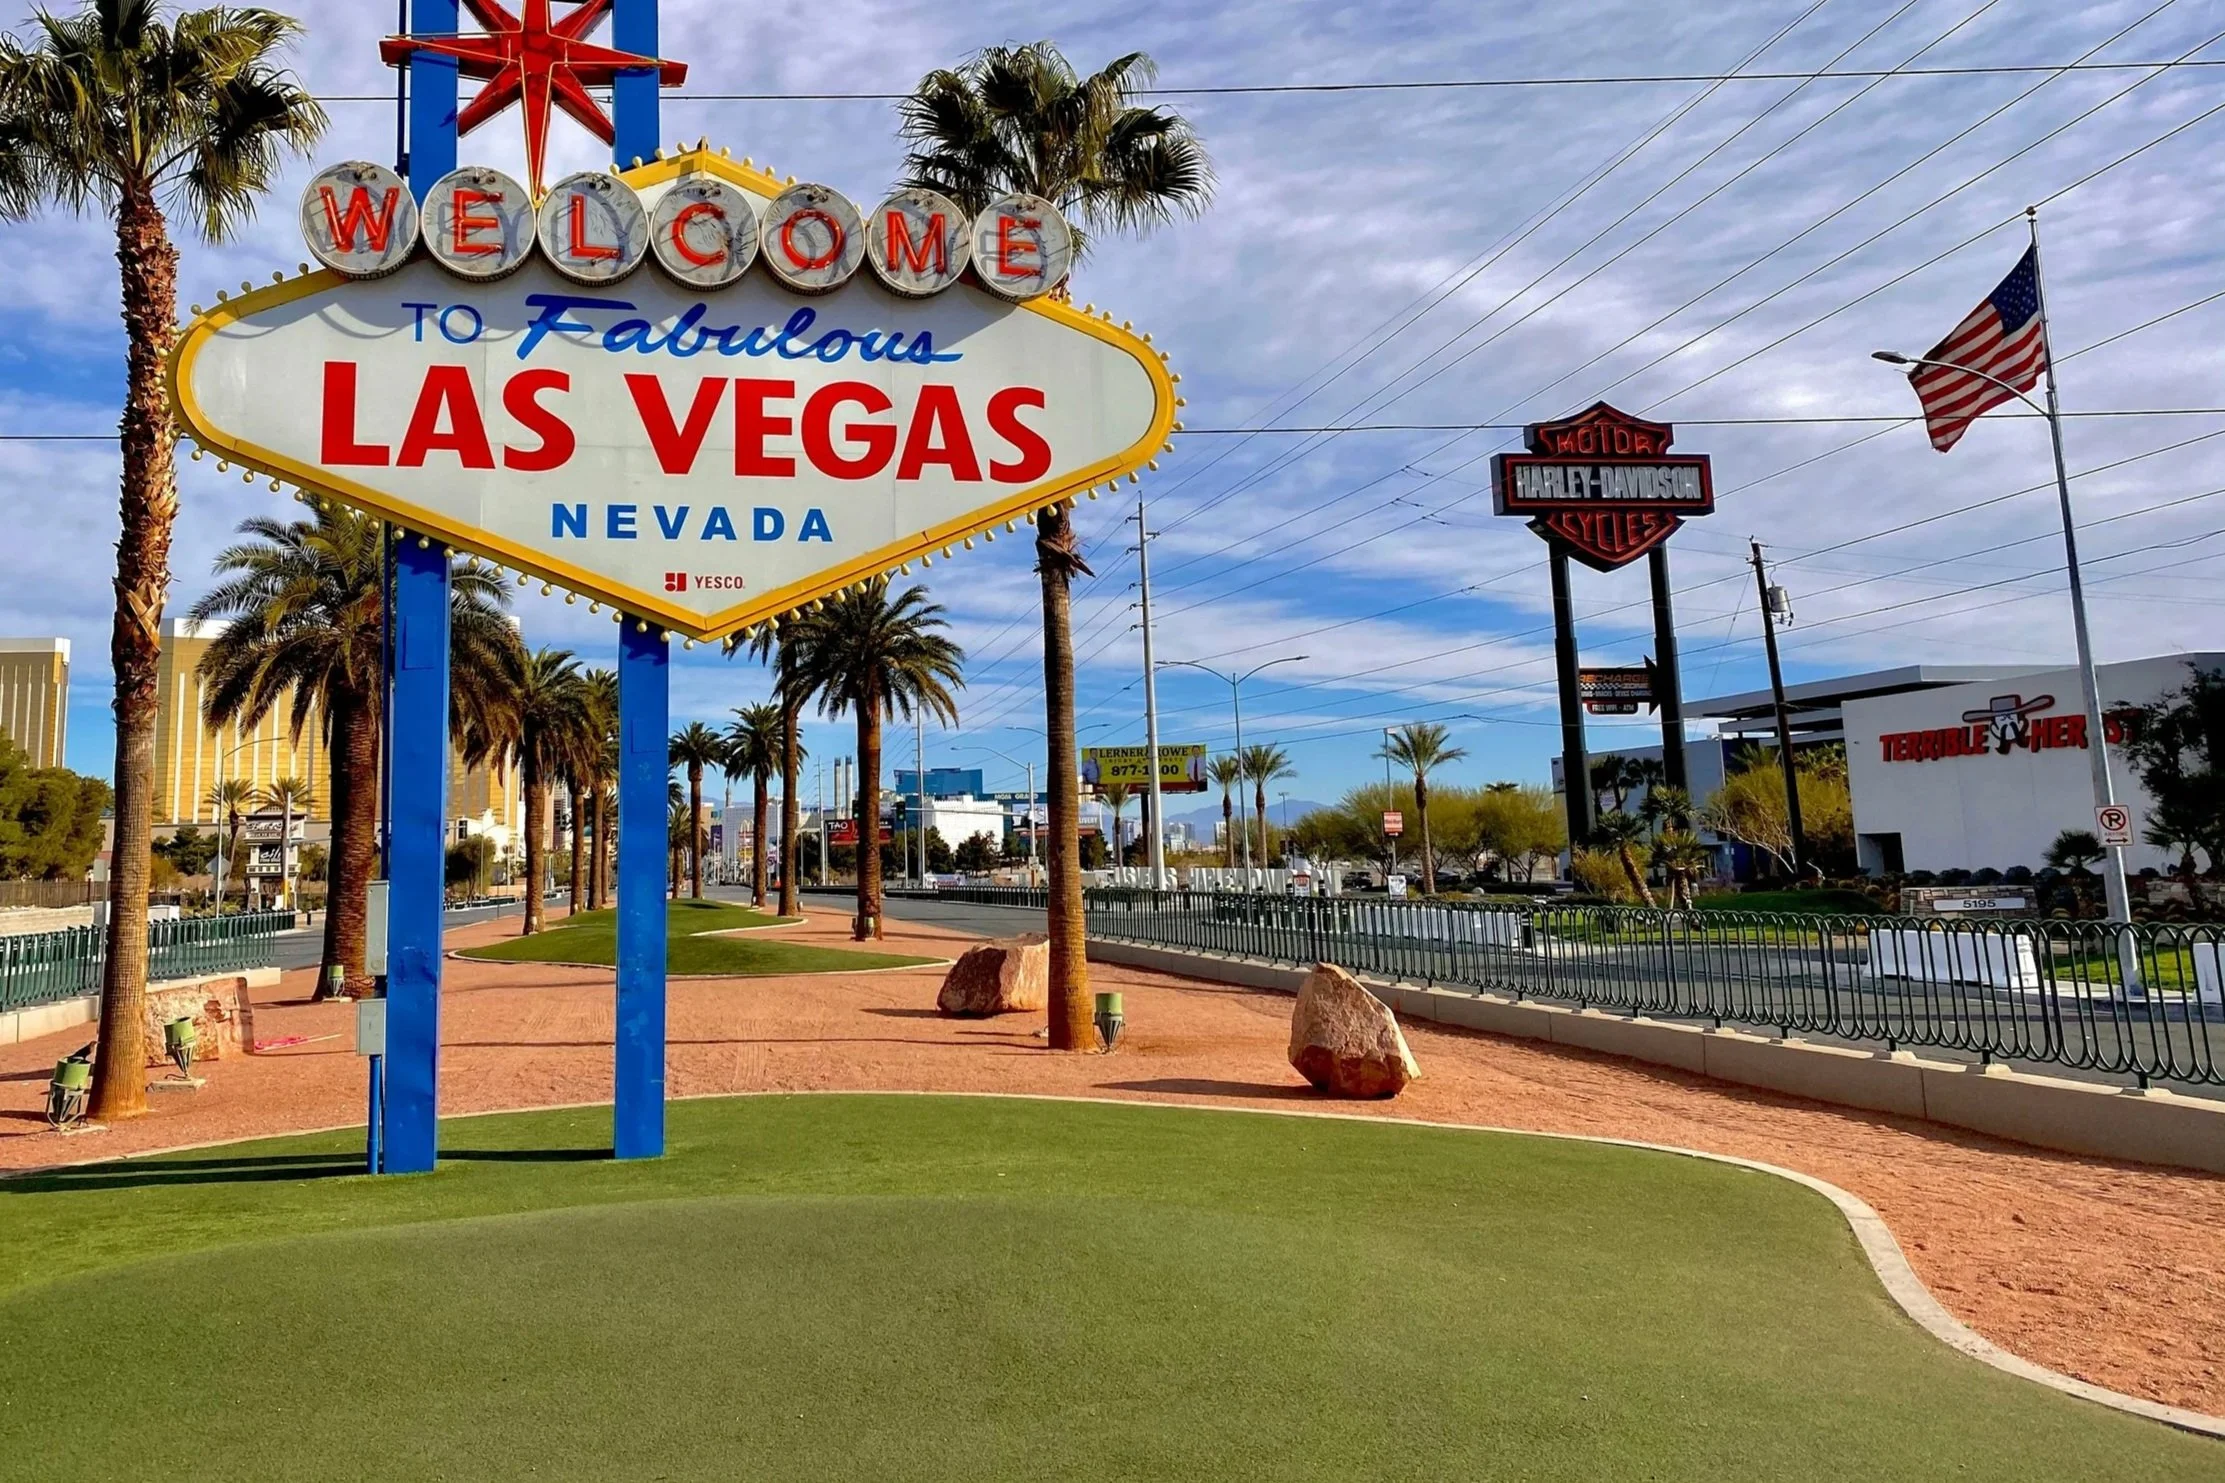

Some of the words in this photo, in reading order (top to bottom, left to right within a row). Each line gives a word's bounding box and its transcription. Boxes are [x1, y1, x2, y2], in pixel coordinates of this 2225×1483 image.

[319, 185, 1042, 278] WELCOME
[401, 302, 483, 345] TO
[516, 292, 964, 366] Fabulous
[320, 360, 576, 473] LAS
[623, 372, 1053, 485] VEGAS
[1556, 422, 1654, 455] MOTOR
[1515, 465, 1702, 499] HARLEY-DAVIDSON
[550, 502, 834, 544] NEVADA
[1561, 511, 1657, 553] CYCLES
[1099, 748, 1143, 758] LERNER
[1879, 724, 1989, 762] TERRIBLE
[1111, 765, 1179, 776] 877-100
[828, 821, 849, 831] TAO
[1963, 899, 1997, 909] 5195
